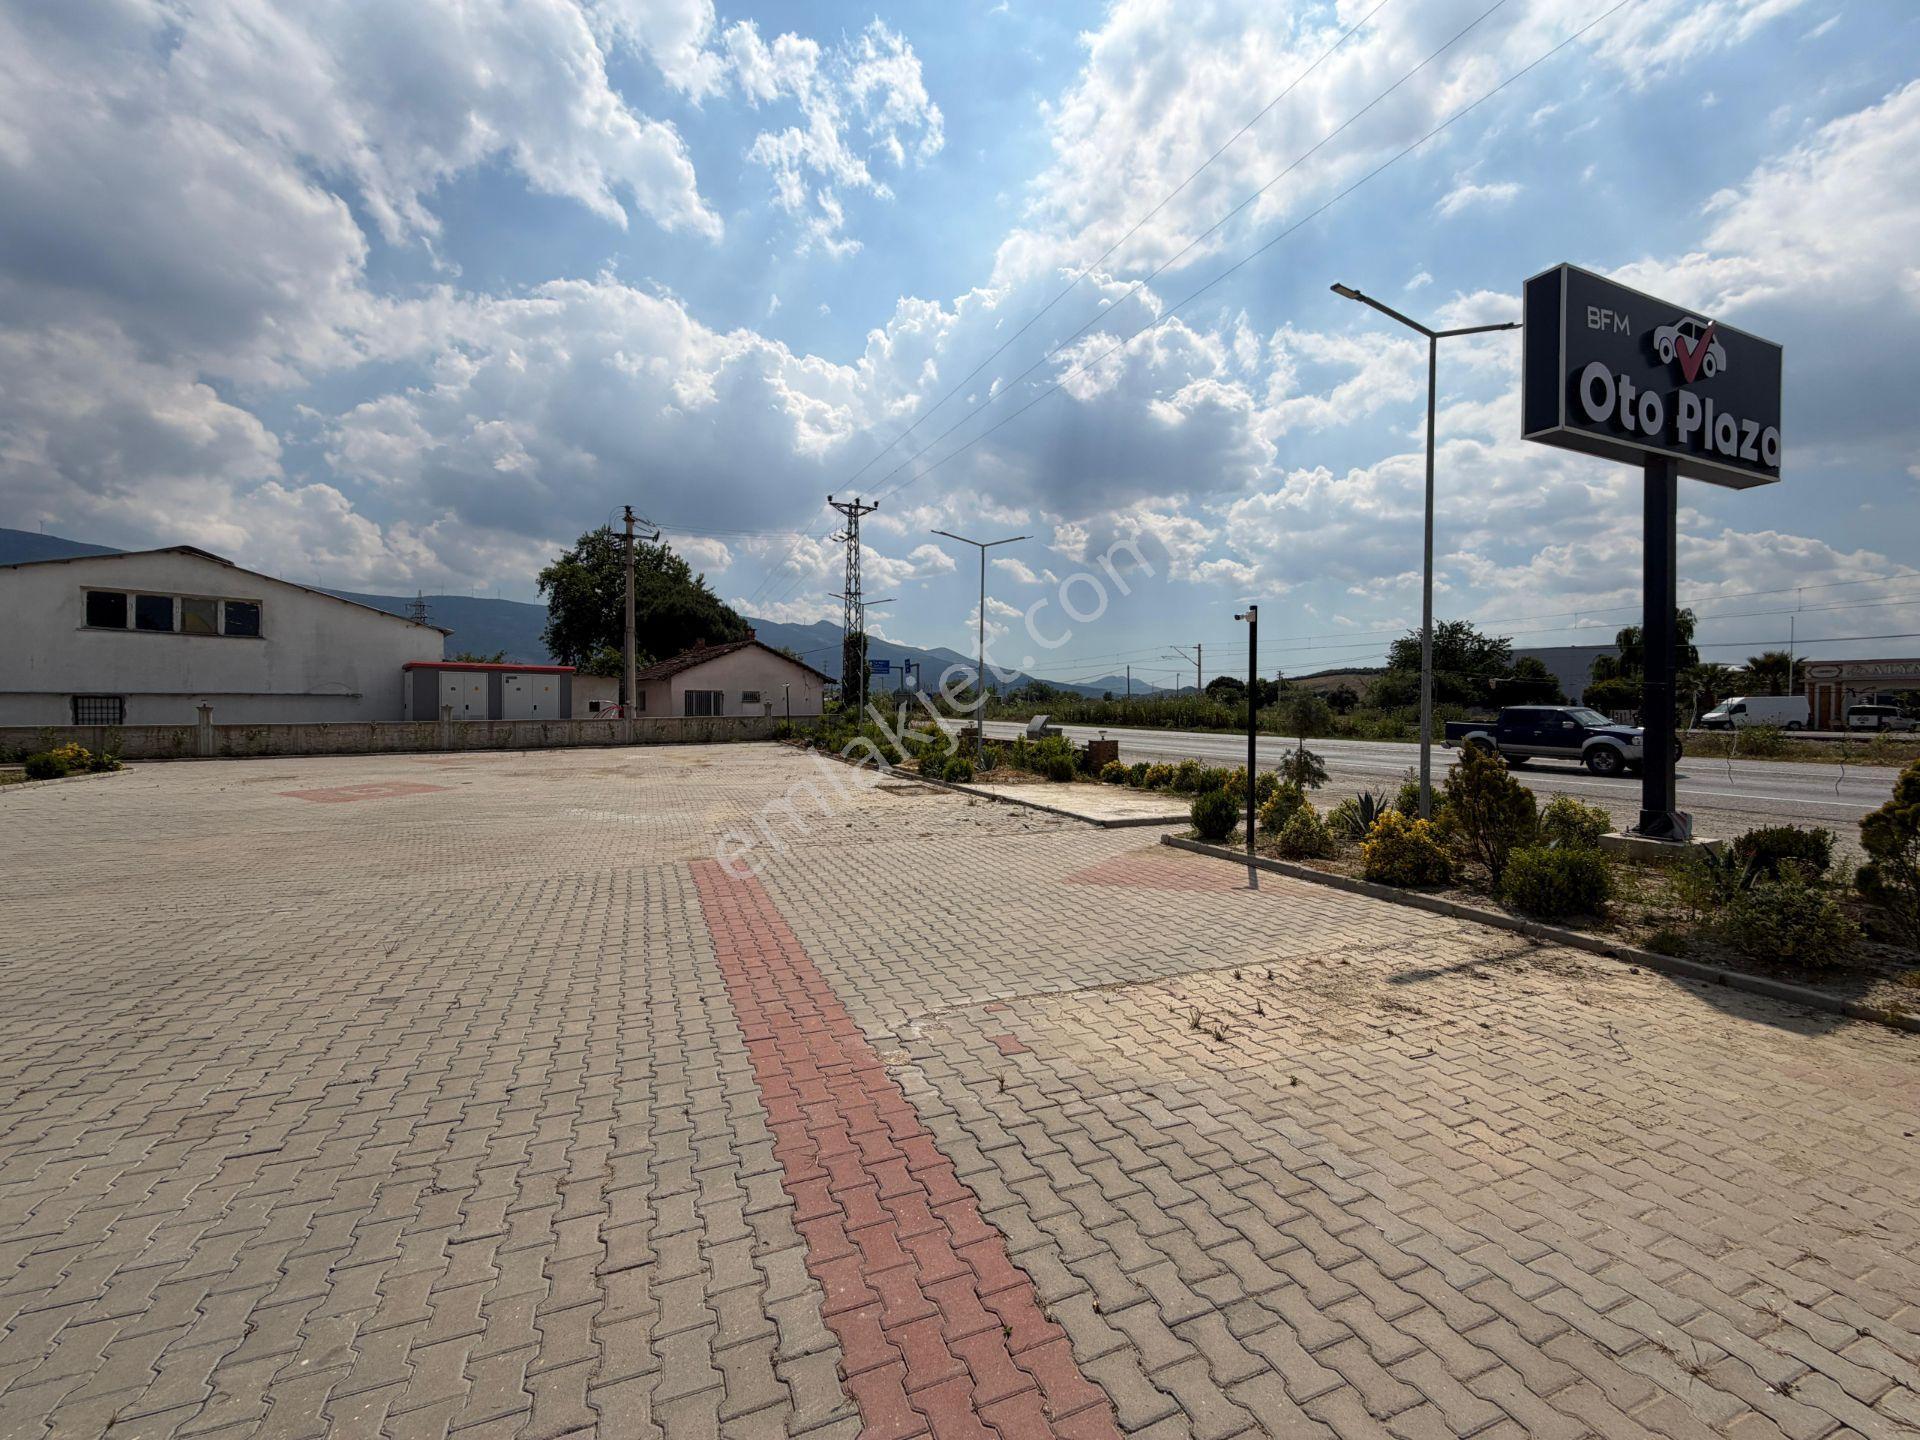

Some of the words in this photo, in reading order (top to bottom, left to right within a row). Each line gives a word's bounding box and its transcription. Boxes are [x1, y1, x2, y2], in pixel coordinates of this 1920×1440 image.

[1587, 306, 1631, 336] BFM
[1580, 361, 1664, 436] Oto
[1676, 389, 1781, 468] Plaza
